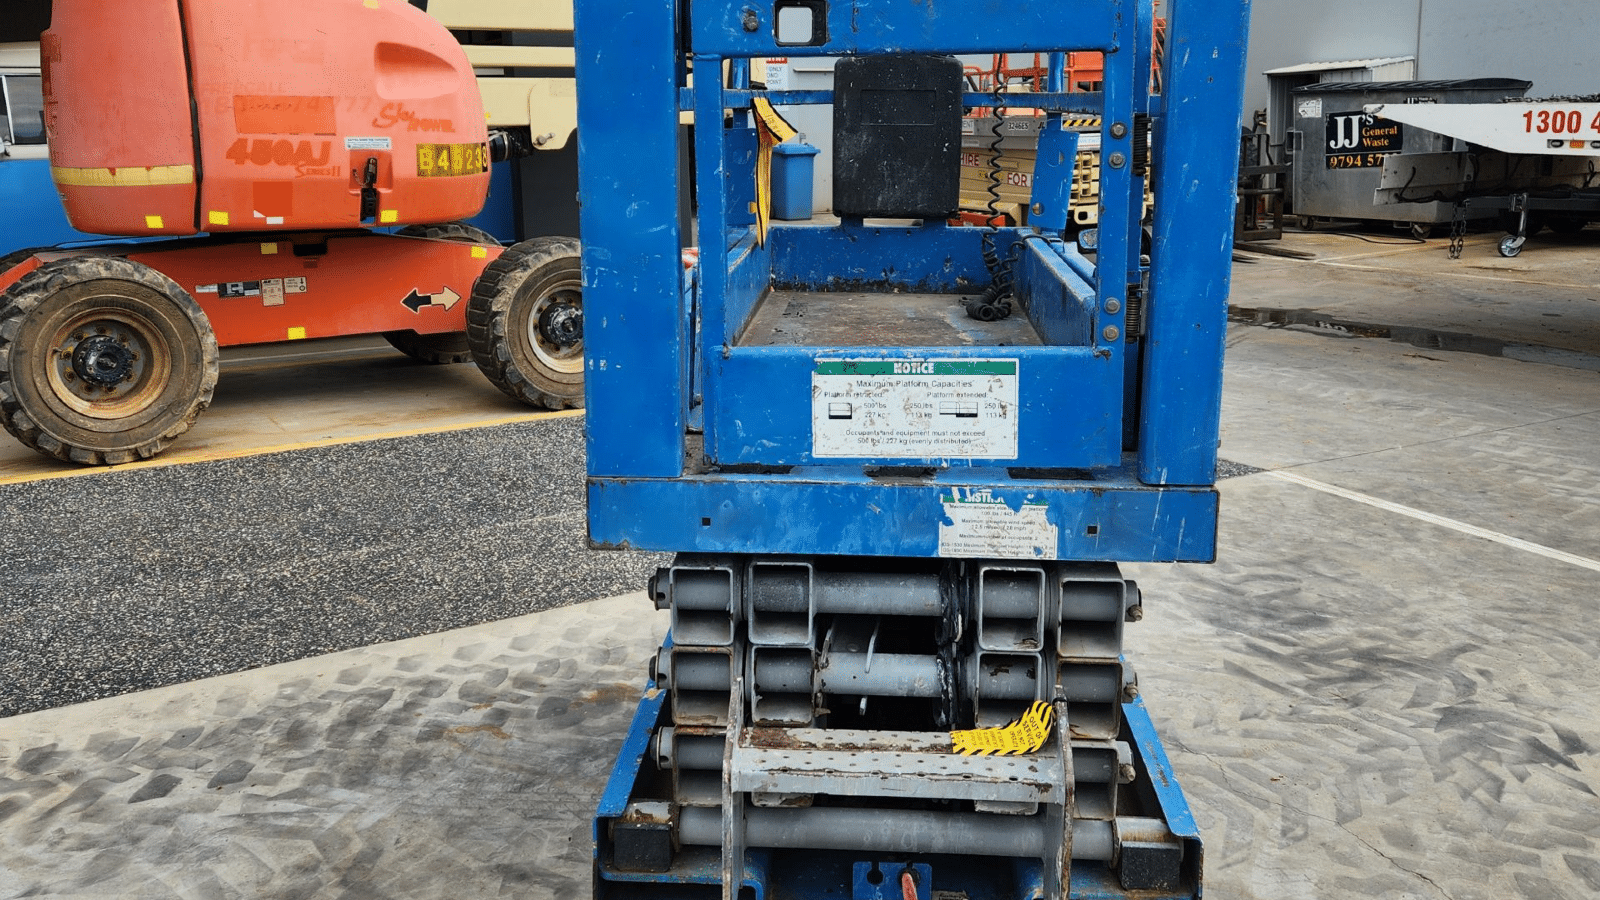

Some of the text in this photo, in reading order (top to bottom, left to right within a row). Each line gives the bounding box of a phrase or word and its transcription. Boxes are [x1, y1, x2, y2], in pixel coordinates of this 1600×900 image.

[1523, 110, 1582, 134] 1300
[1362, 125, 1398, 137] General
[1362, 137, 1390, 148] Waste
[226, 138, 332, 167] 450AJ
[1330, 154, 1362, 167] 9794
[1007, 172, 1028, 187] FOR
[893, 362, 935, 374] NOTICE
[856, 380, 973, 389] Maximum Platform Capacities
[846, 429, 880, 437] Occupants
[899, 438, 908, 446] kg
[1023, 720, 1036, 746] SERVICE
[1030, 716, 1043, 739] OUT OF
